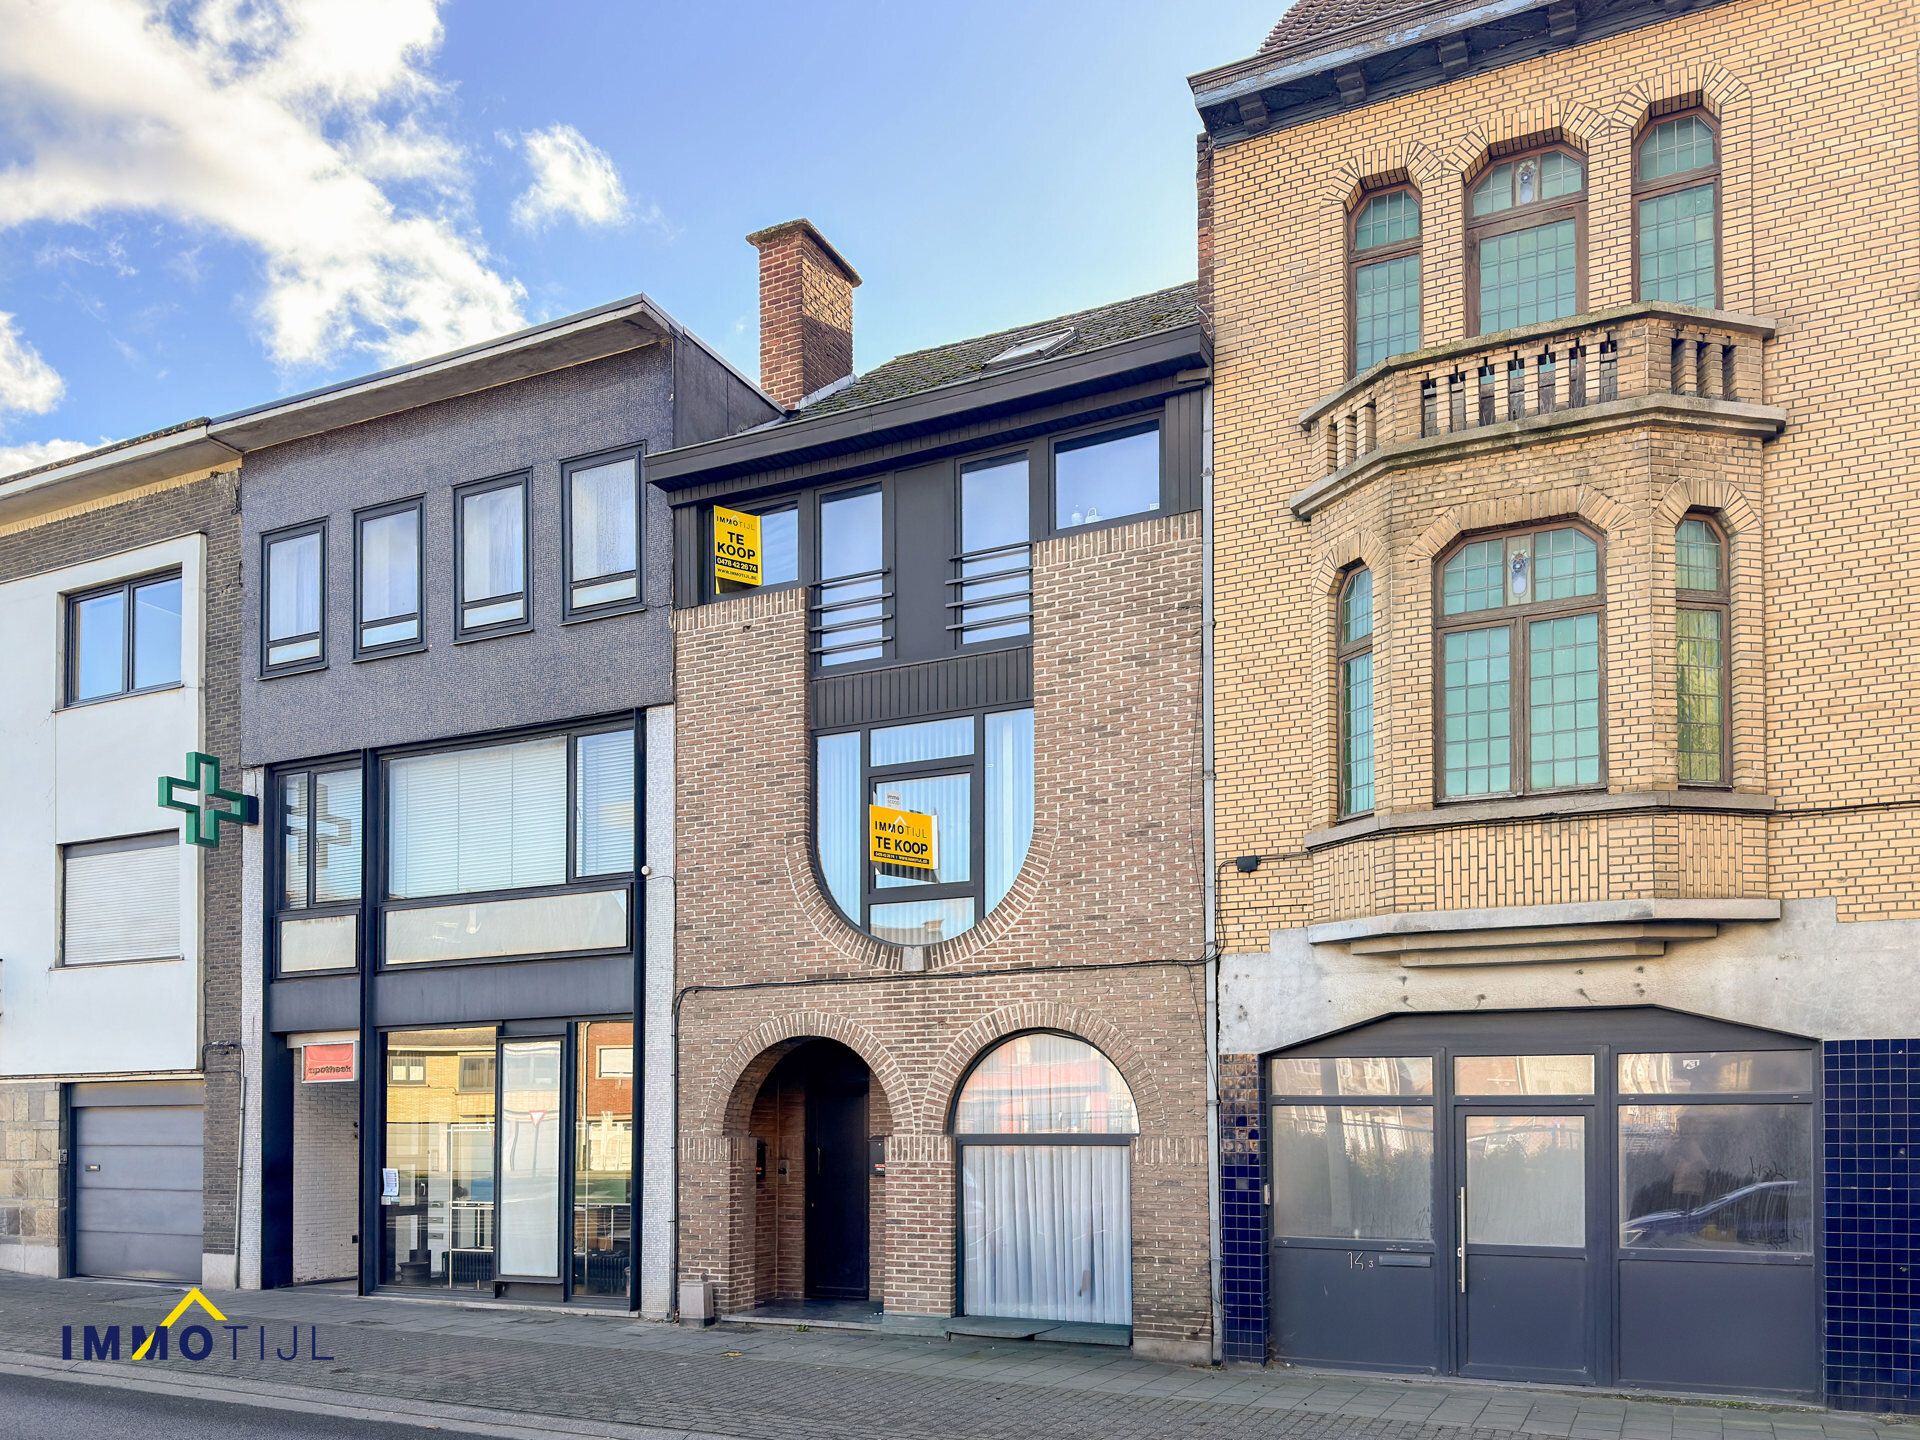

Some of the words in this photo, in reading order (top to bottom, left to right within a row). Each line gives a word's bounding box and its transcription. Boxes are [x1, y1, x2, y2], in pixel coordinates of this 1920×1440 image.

[716, 515, 755, 531] IMMOTIJL
[727, 531, 745, 546] TE
[717, 541, 756, 560] KOOP
[716, 557, 732, 567] 0478
[732, 561, 740, 569] 42
[749, 564, 757, 572] 74
[874, 820, 927, 839] IMMOTIJL
[875, 835, 892, 850] TE
[894, 839, 929, 855] KOOP
